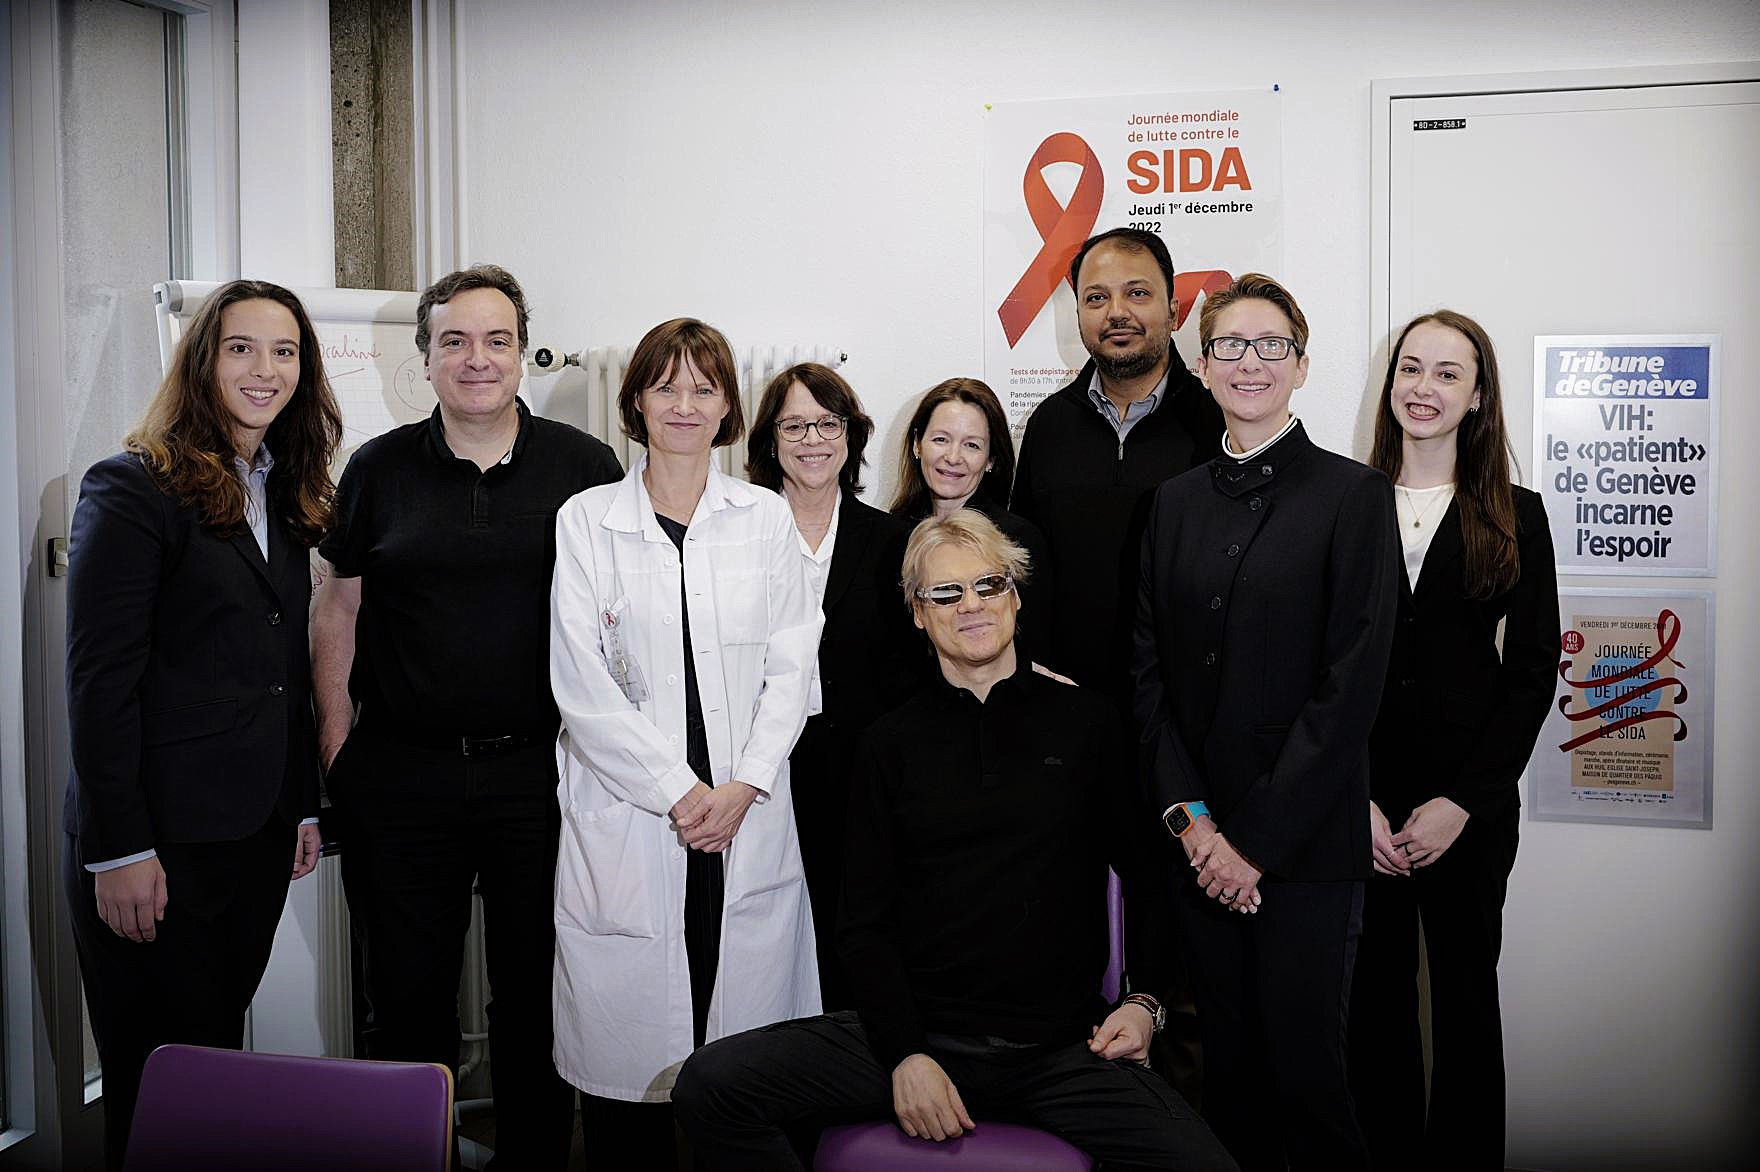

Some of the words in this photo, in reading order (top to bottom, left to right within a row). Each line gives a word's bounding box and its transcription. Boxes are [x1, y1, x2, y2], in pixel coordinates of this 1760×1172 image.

[1127, 111, 1179, 126] Journée
[1181, 110, 1239, 123] mondiale
[1127, 130, 1144, 143] de
[1147, 130, 1177, 142] lutte
[1181, 129, 1223, 141] contre
[1228, 127, 1239, 139] le
[1126, 147, 1252, 195] SIDA
[1128, 202, 1165, 216] Jeudi
[1169, 202, 1182, 215] 1er
[1185, 200, 1253, 215] décembre
[1129, 221, 1162, 234] 2022
[1558, 350, 1665, 373] Tribune
[1010, 368, 1028, 376] Tests
[1029, 368, 1038, 376] de
[1039, 368, 1074, 377] dépistage
[1010, 391, 1047, 399] Pandémies
[1599, 404, 1654, 431] VIH:
[1546, 434, 1569, 461] le
[1576, 435, 1706, 467] «patient»
[1554, 466, 1588, 493] de
[1596, 466, 1696, 495] Genève
[1576, 497, 1673, 525] incarne
[1566, 633, 1578, 643] 40
[1594, 643, 1652, 659] JOURNÉE
[1594, 685, 1611, 698] DE
[1617, 726, 1646, 740] SIDA
